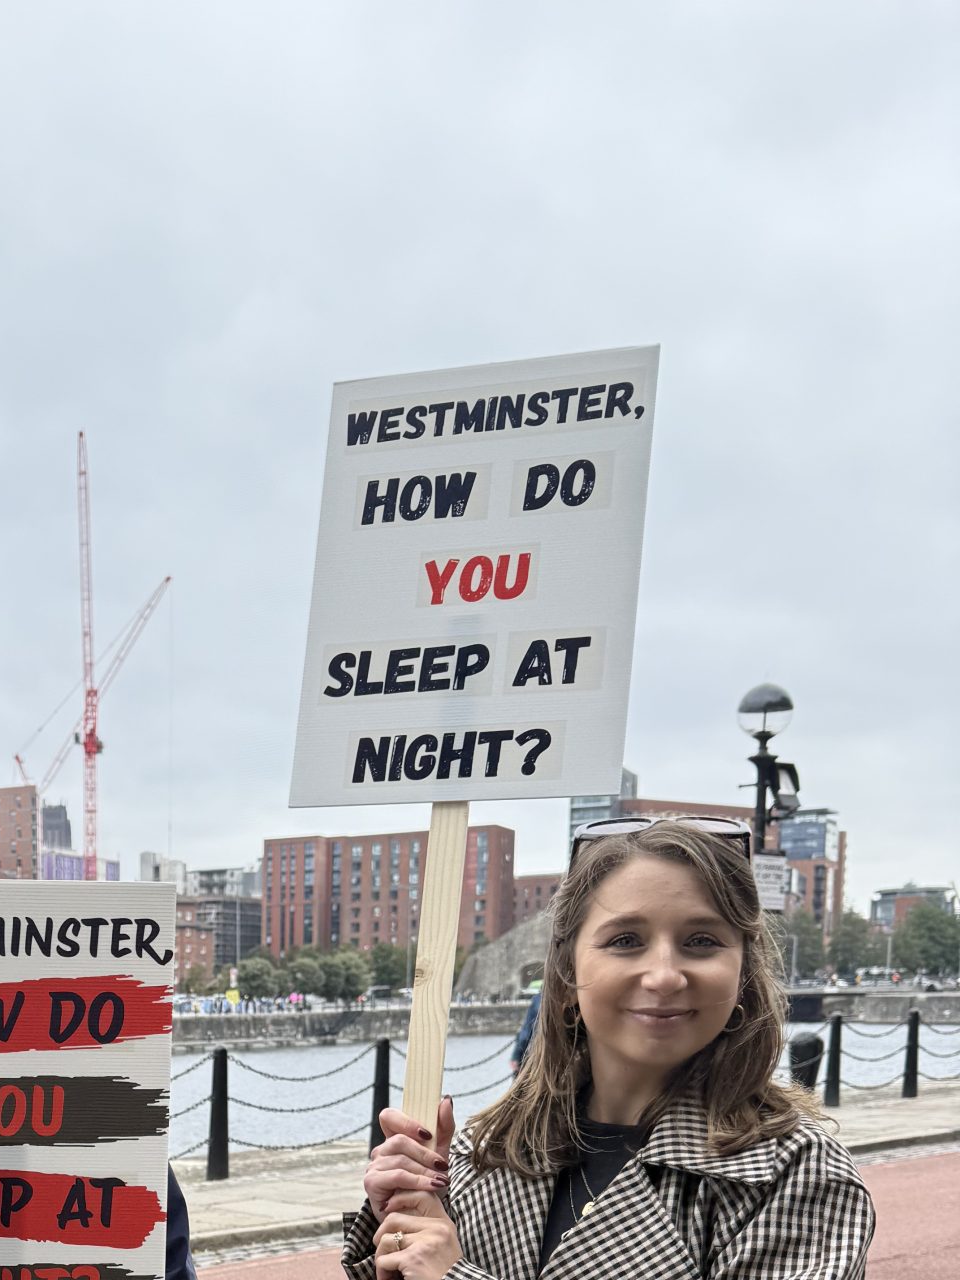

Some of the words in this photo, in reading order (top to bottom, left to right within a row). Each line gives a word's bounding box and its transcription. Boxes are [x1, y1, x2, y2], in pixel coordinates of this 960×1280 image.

[347, 382, 645, 446] WESTMINSTER,
[361, 471, 477, 526] HOW
[522, 459, 596, 511] DO
[425, 553, 530, 605] YOU
[323, 643, 490, 698] SLEEP
[512, 636, 592, 687] AT
[352, 728, 552, 784] NIGHT?
[48, 991, 125, 1045] DO
[56, 1177, 126, 1230] AT
